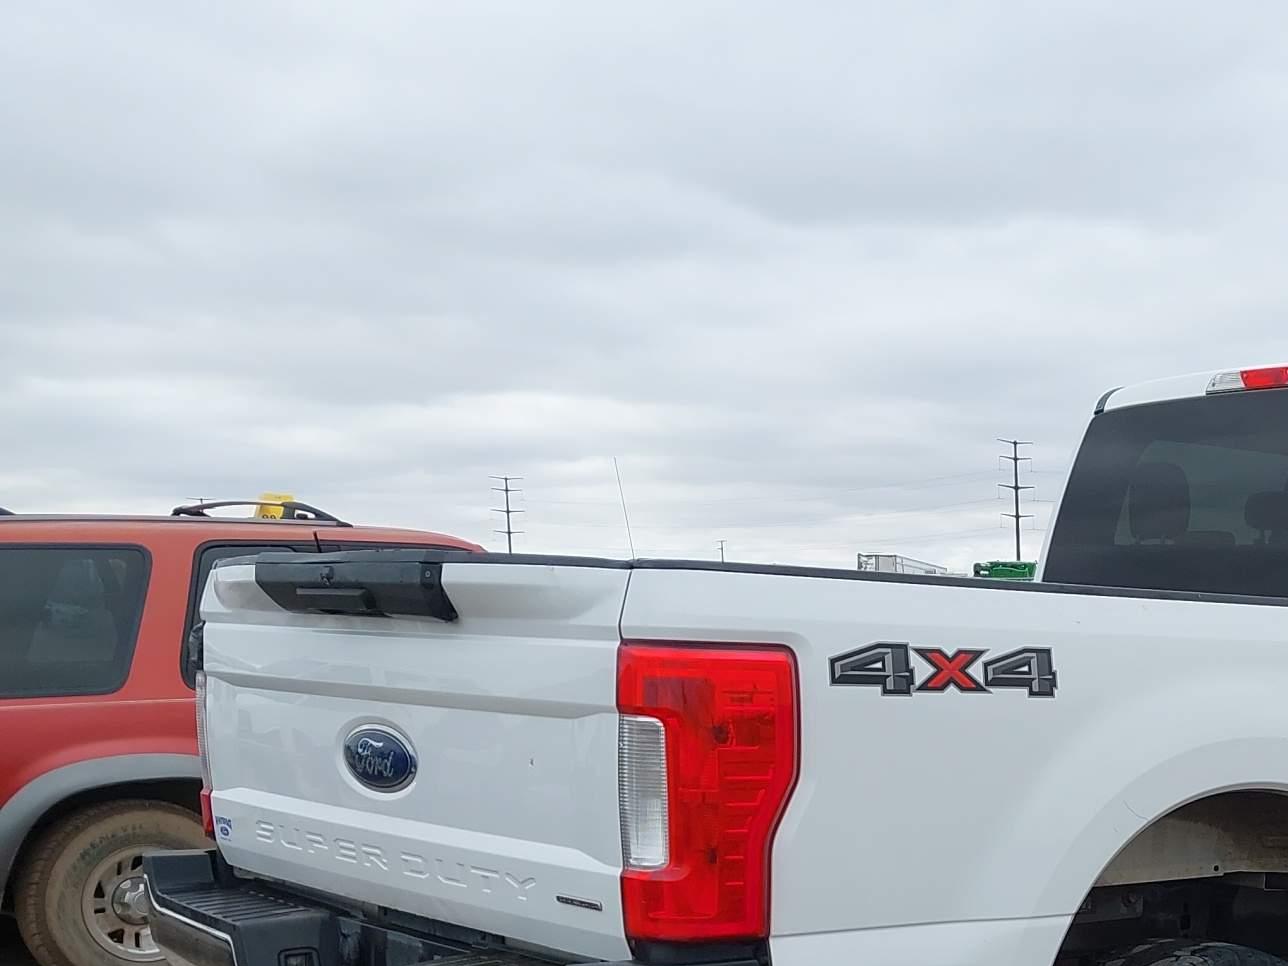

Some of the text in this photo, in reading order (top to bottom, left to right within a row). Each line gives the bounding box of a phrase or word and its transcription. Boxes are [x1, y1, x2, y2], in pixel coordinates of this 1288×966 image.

[354, 737, 394, 777] Ford
[255, 819, 537, 901] SUPER DUTY
